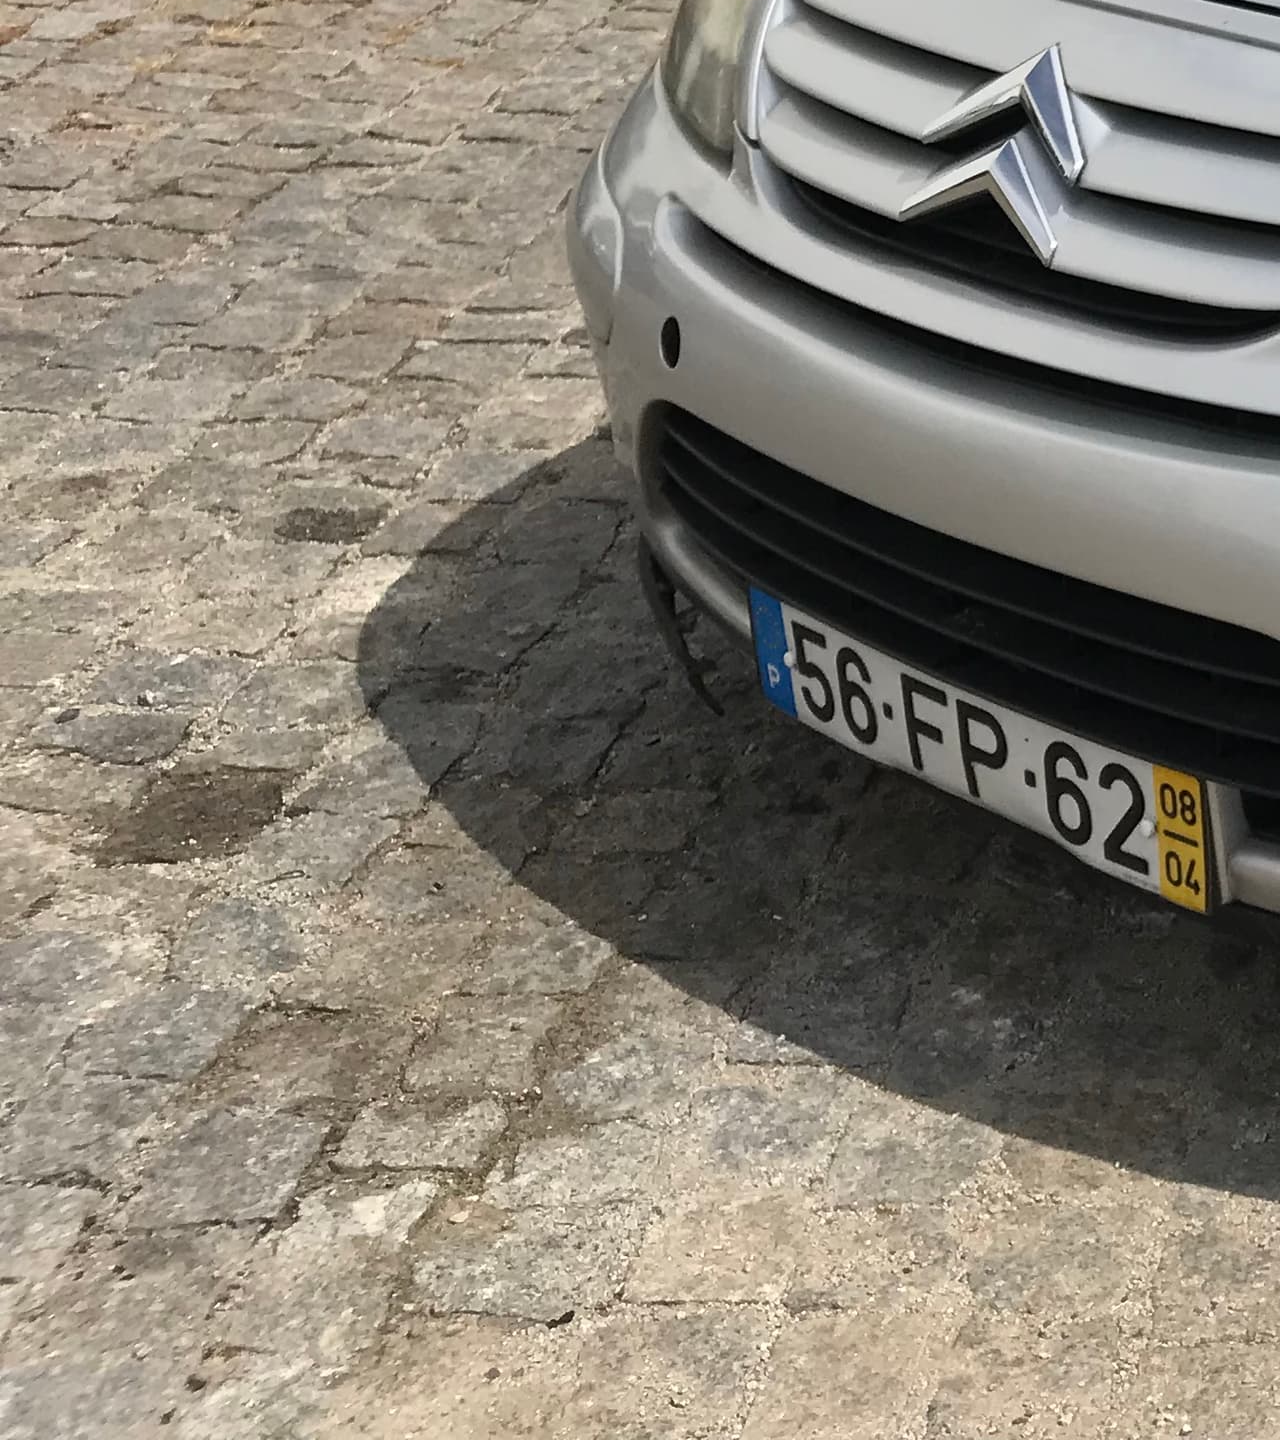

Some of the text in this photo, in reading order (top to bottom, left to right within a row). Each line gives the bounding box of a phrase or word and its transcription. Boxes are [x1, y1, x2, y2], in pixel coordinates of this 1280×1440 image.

[768, 663, 781, 688] P
[1159, 783, 1196, 826] 08
[1165, 851, 1200, 895] 04
